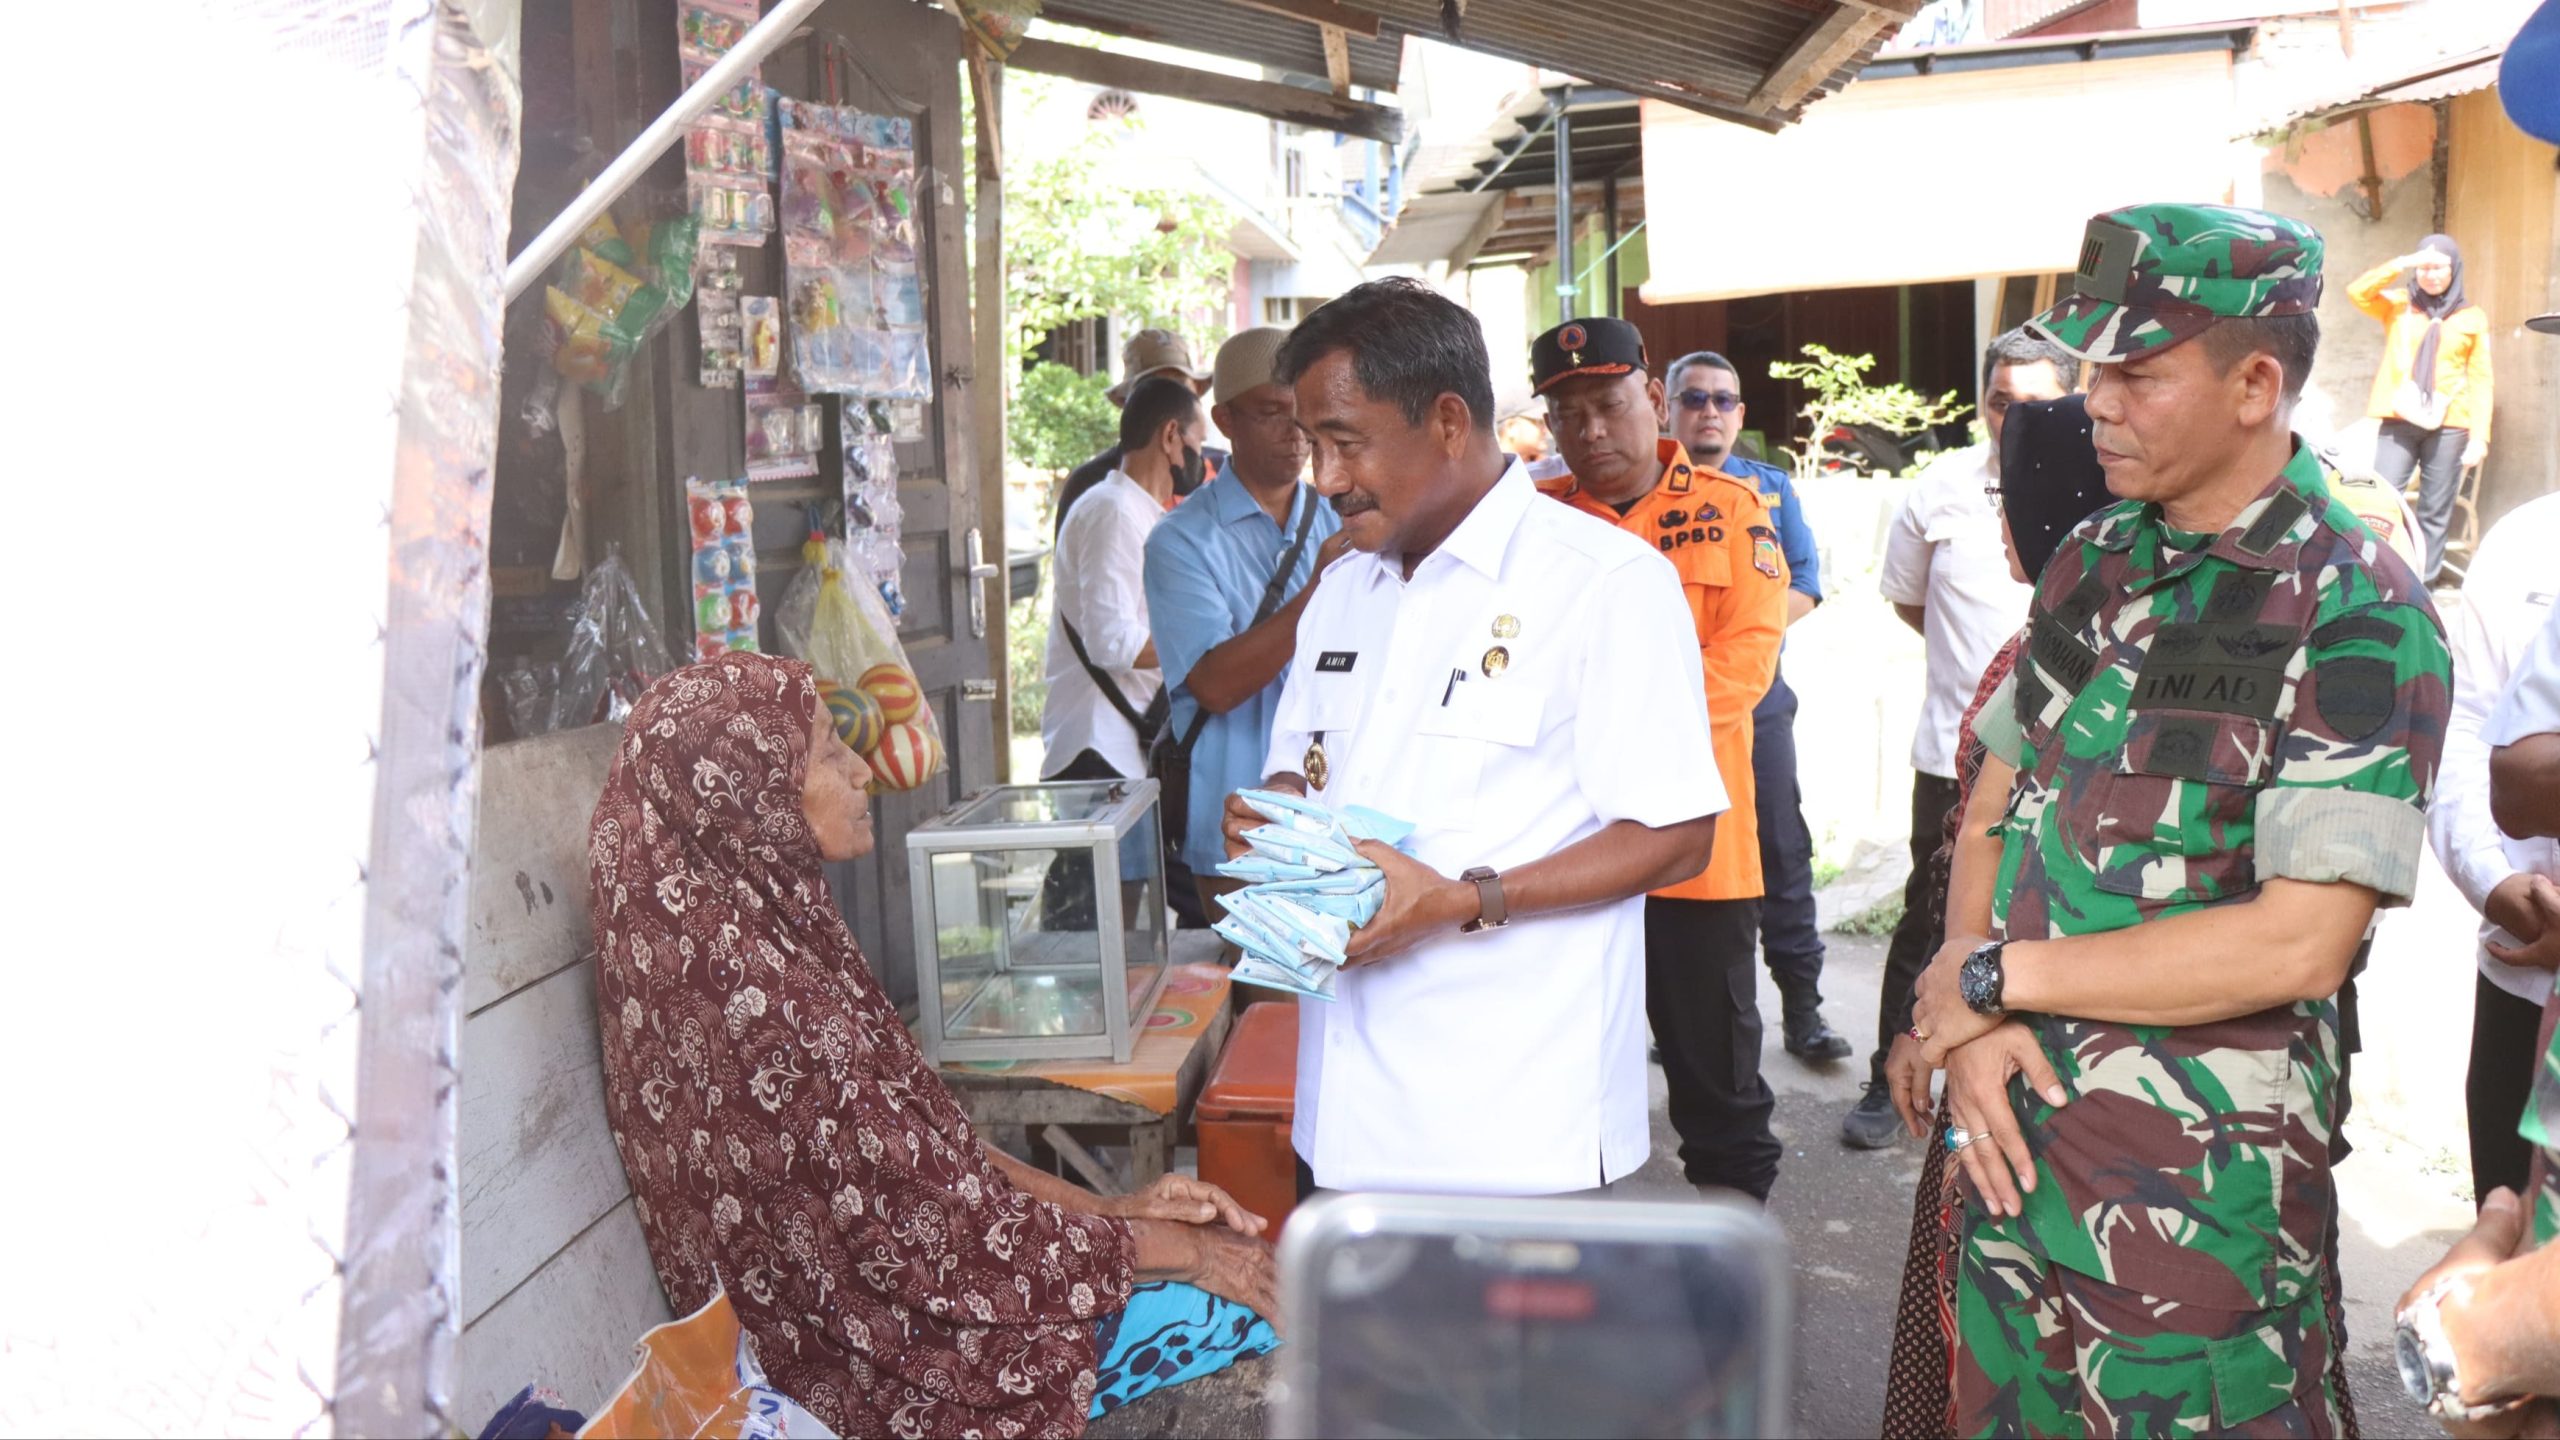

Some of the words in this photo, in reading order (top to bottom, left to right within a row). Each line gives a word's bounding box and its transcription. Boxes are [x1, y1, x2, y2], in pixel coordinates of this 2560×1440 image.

[1660, 525, 1724, 551] BPBD
[1325, 656, 1347, 667] AMIR
[2146, 674, 2196, 700] TNI
[2202, 675, 2258, 704] AD
